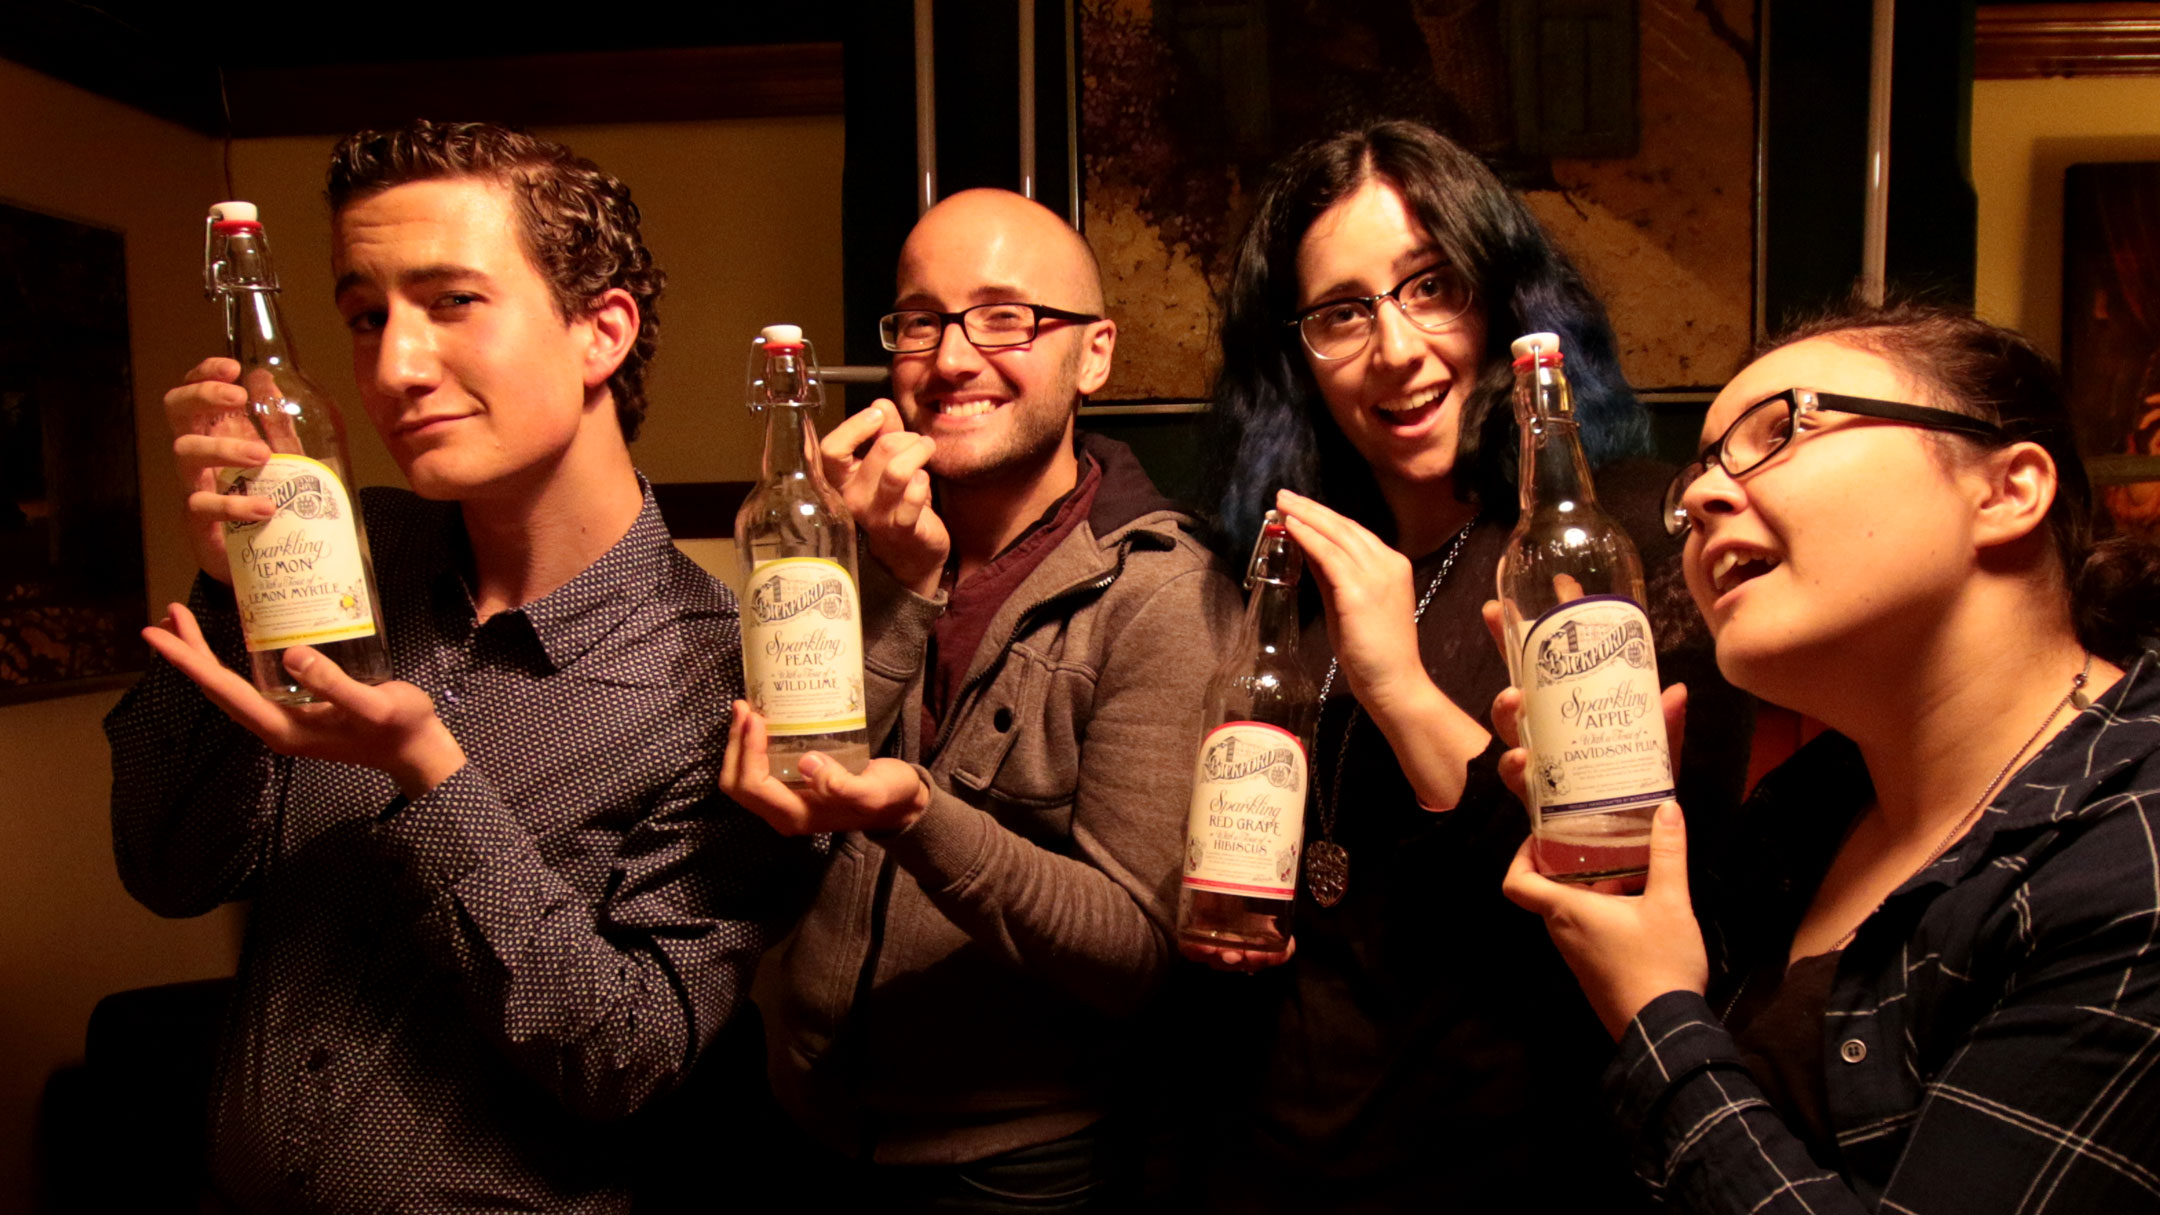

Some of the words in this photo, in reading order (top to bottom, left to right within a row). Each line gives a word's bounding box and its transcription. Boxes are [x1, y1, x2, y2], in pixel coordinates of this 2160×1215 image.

[241, 529, 333, 572] Sparkling
[256, 558, 314, 579] LEMON
[249, 588, 287, 605] LEMON
[290, 582, 340, 600] MYRTLE
[766, 628, 847, 664] Sparkling
[1543, 624, 1628, 680] BICKFORD
[785, 653, 824, 666] PEAR
[773, 679, 807, 692] WILD
[809, 679, 841, 691] LIME
[1560, 679, 1654, 728] Sparkling
[1584, 709, 1634, 730] APPLE
[1564, 741, 1632, 763] DAVIDSON
[1209, 789, 1282, 821] Sparkling
[1209, 815, 1234, 829] RED
[1236, 817, 1282, 837] GRAPE
[1213, 838, 1268, 855] HIBISCUS
